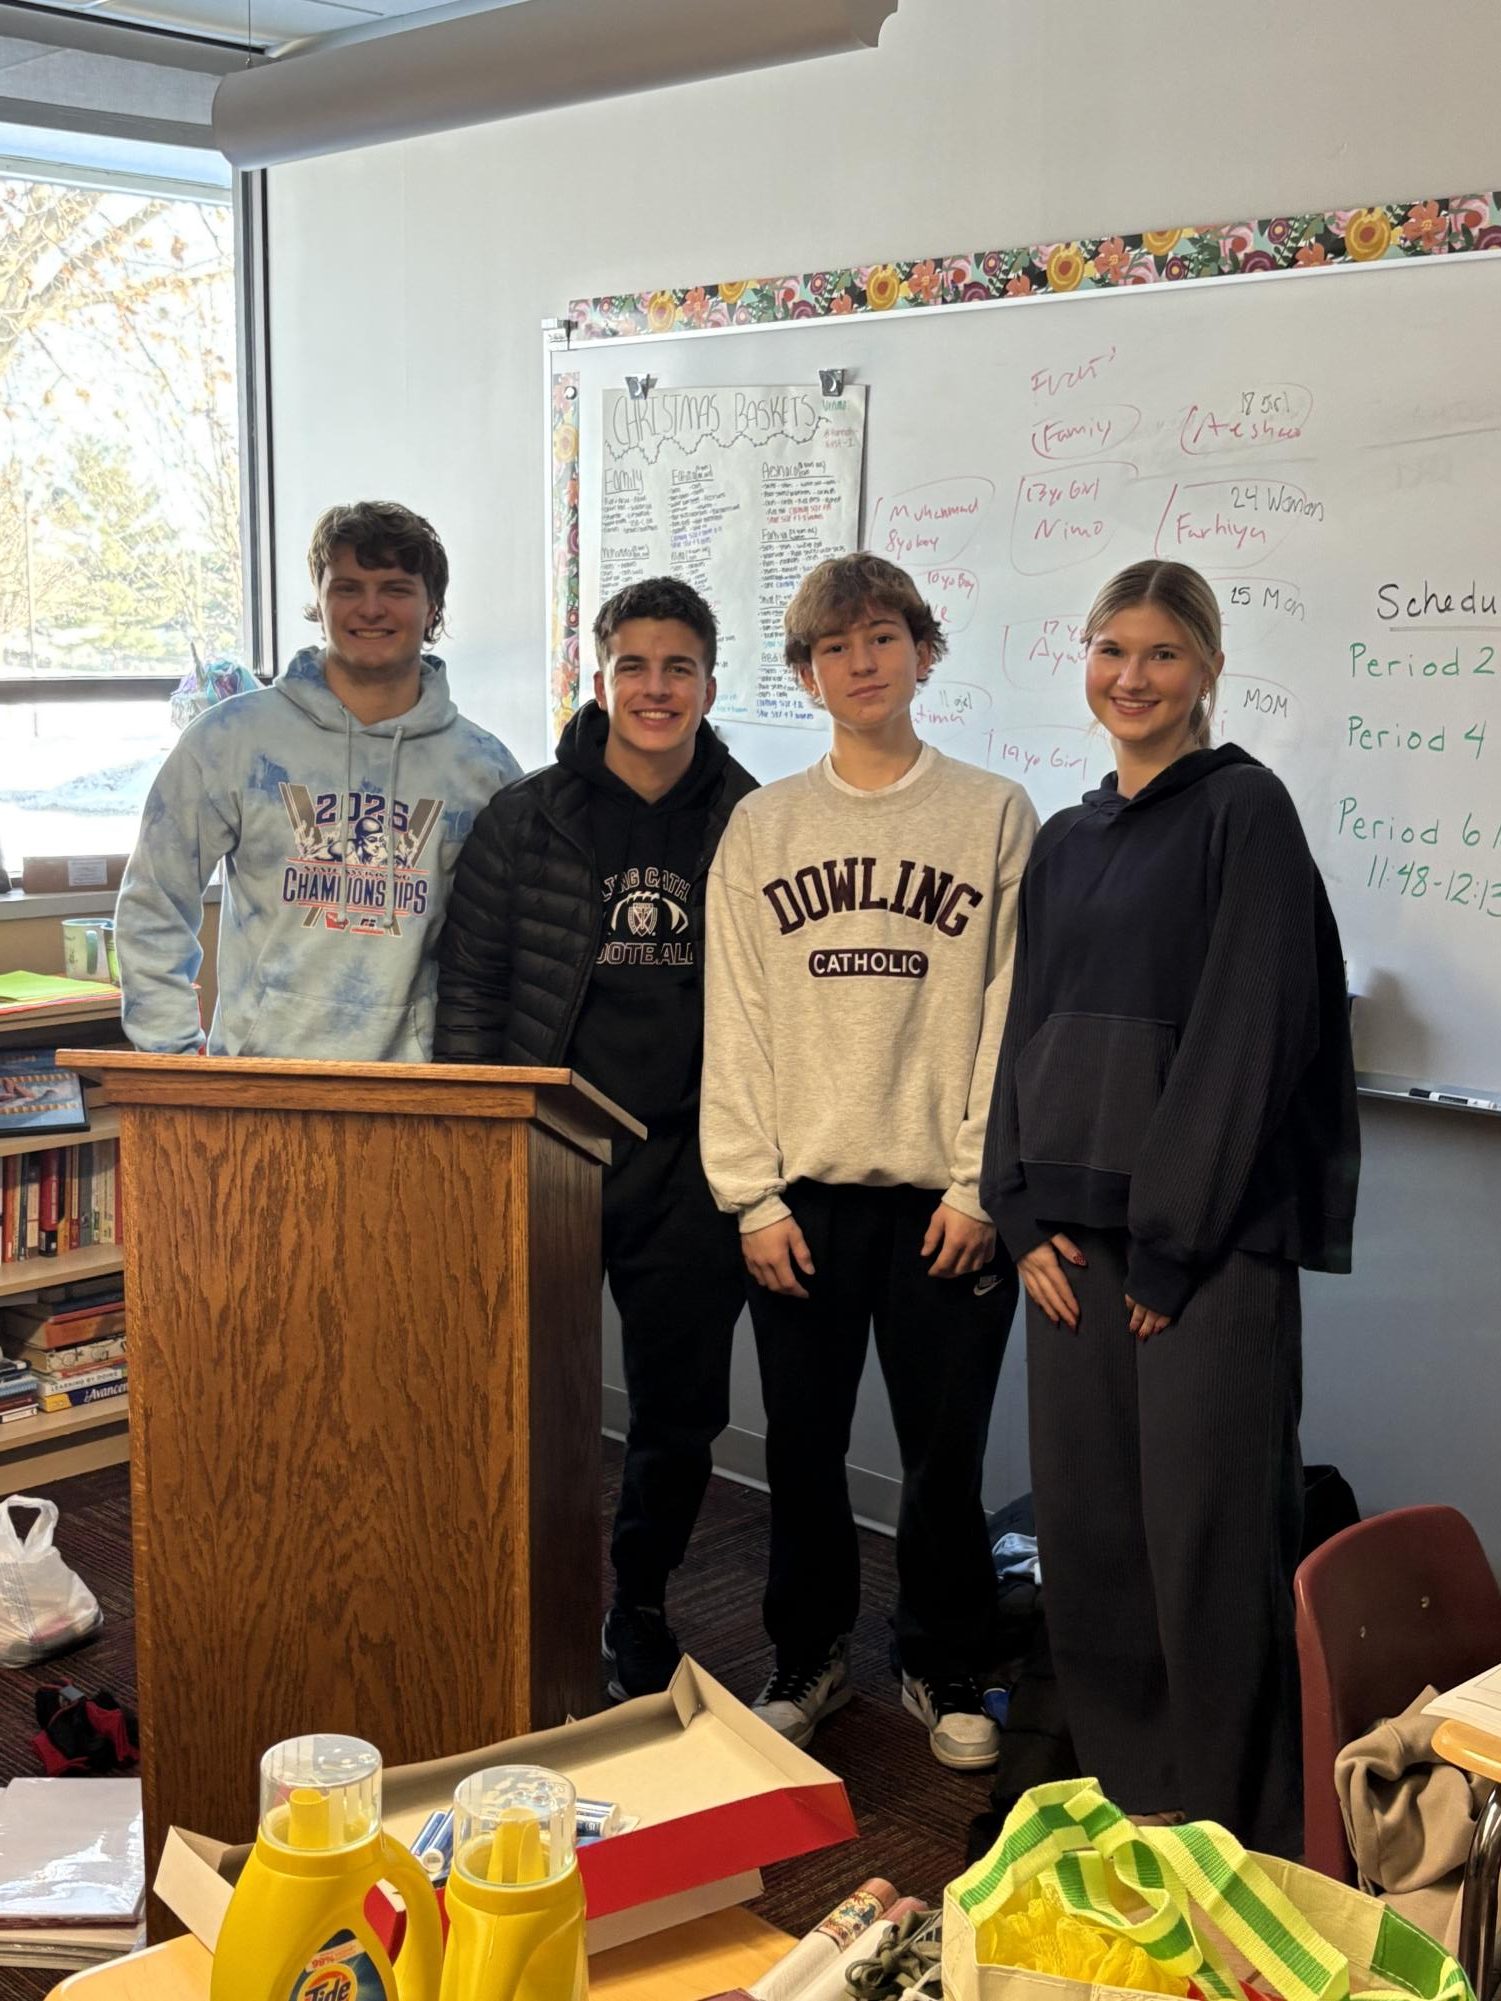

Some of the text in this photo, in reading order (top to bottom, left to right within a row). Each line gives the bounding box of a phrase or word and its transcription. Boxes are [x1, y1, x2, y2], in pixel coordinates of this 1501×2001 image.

[612, 391, 816, 449] CHRISTMAS BASKETS
[1231, 485, 1259, 511] 24
[1377, 579, 1498, 621] Schedu
[1043, 620, 1060, 635] 17
[1349, 642, 1496, 678] Period 2
[1243, 687, 1288, 719] MOM
[1348, 715, 1487, 760] Period 4
[1049, 746, 1088, 783] Girl
[1338, 796, 1440, 845] Period
[761, 856, 984, 938] DOWLING
[812, 951, 923, 975] CATHOLIC
[304, 1978, 352, 2001] Tide
